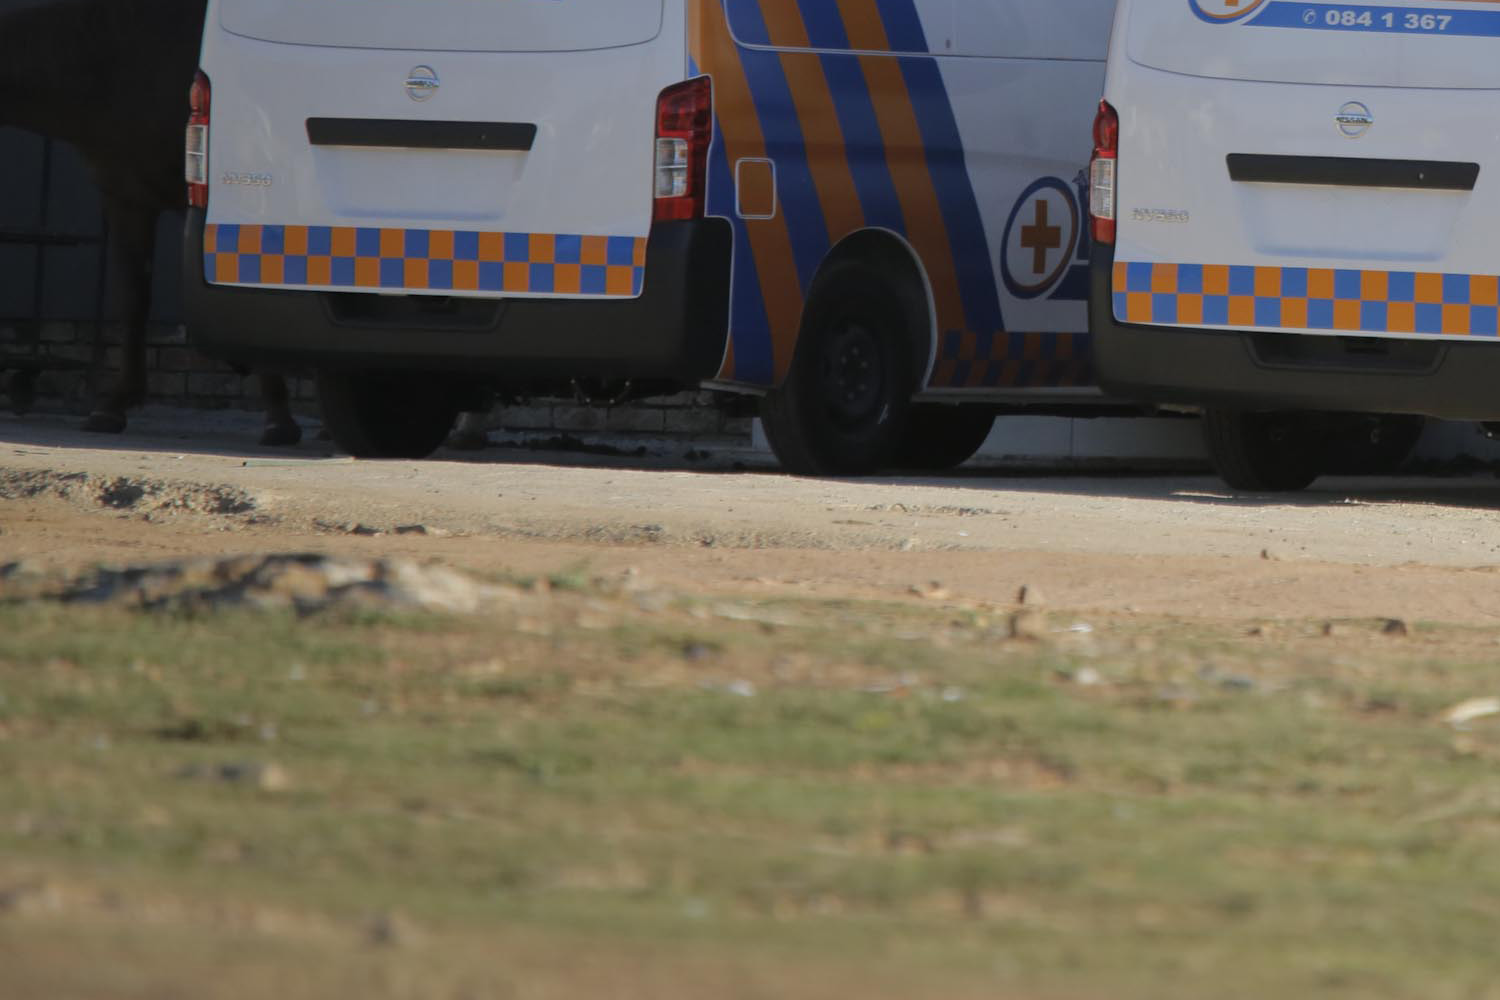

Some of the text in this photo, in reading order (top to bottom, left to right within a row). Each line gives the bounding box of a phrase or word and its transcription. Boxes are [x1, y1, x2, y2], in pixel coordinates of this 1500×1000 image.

[1324, 9, 1453, 31] 084 1 367
